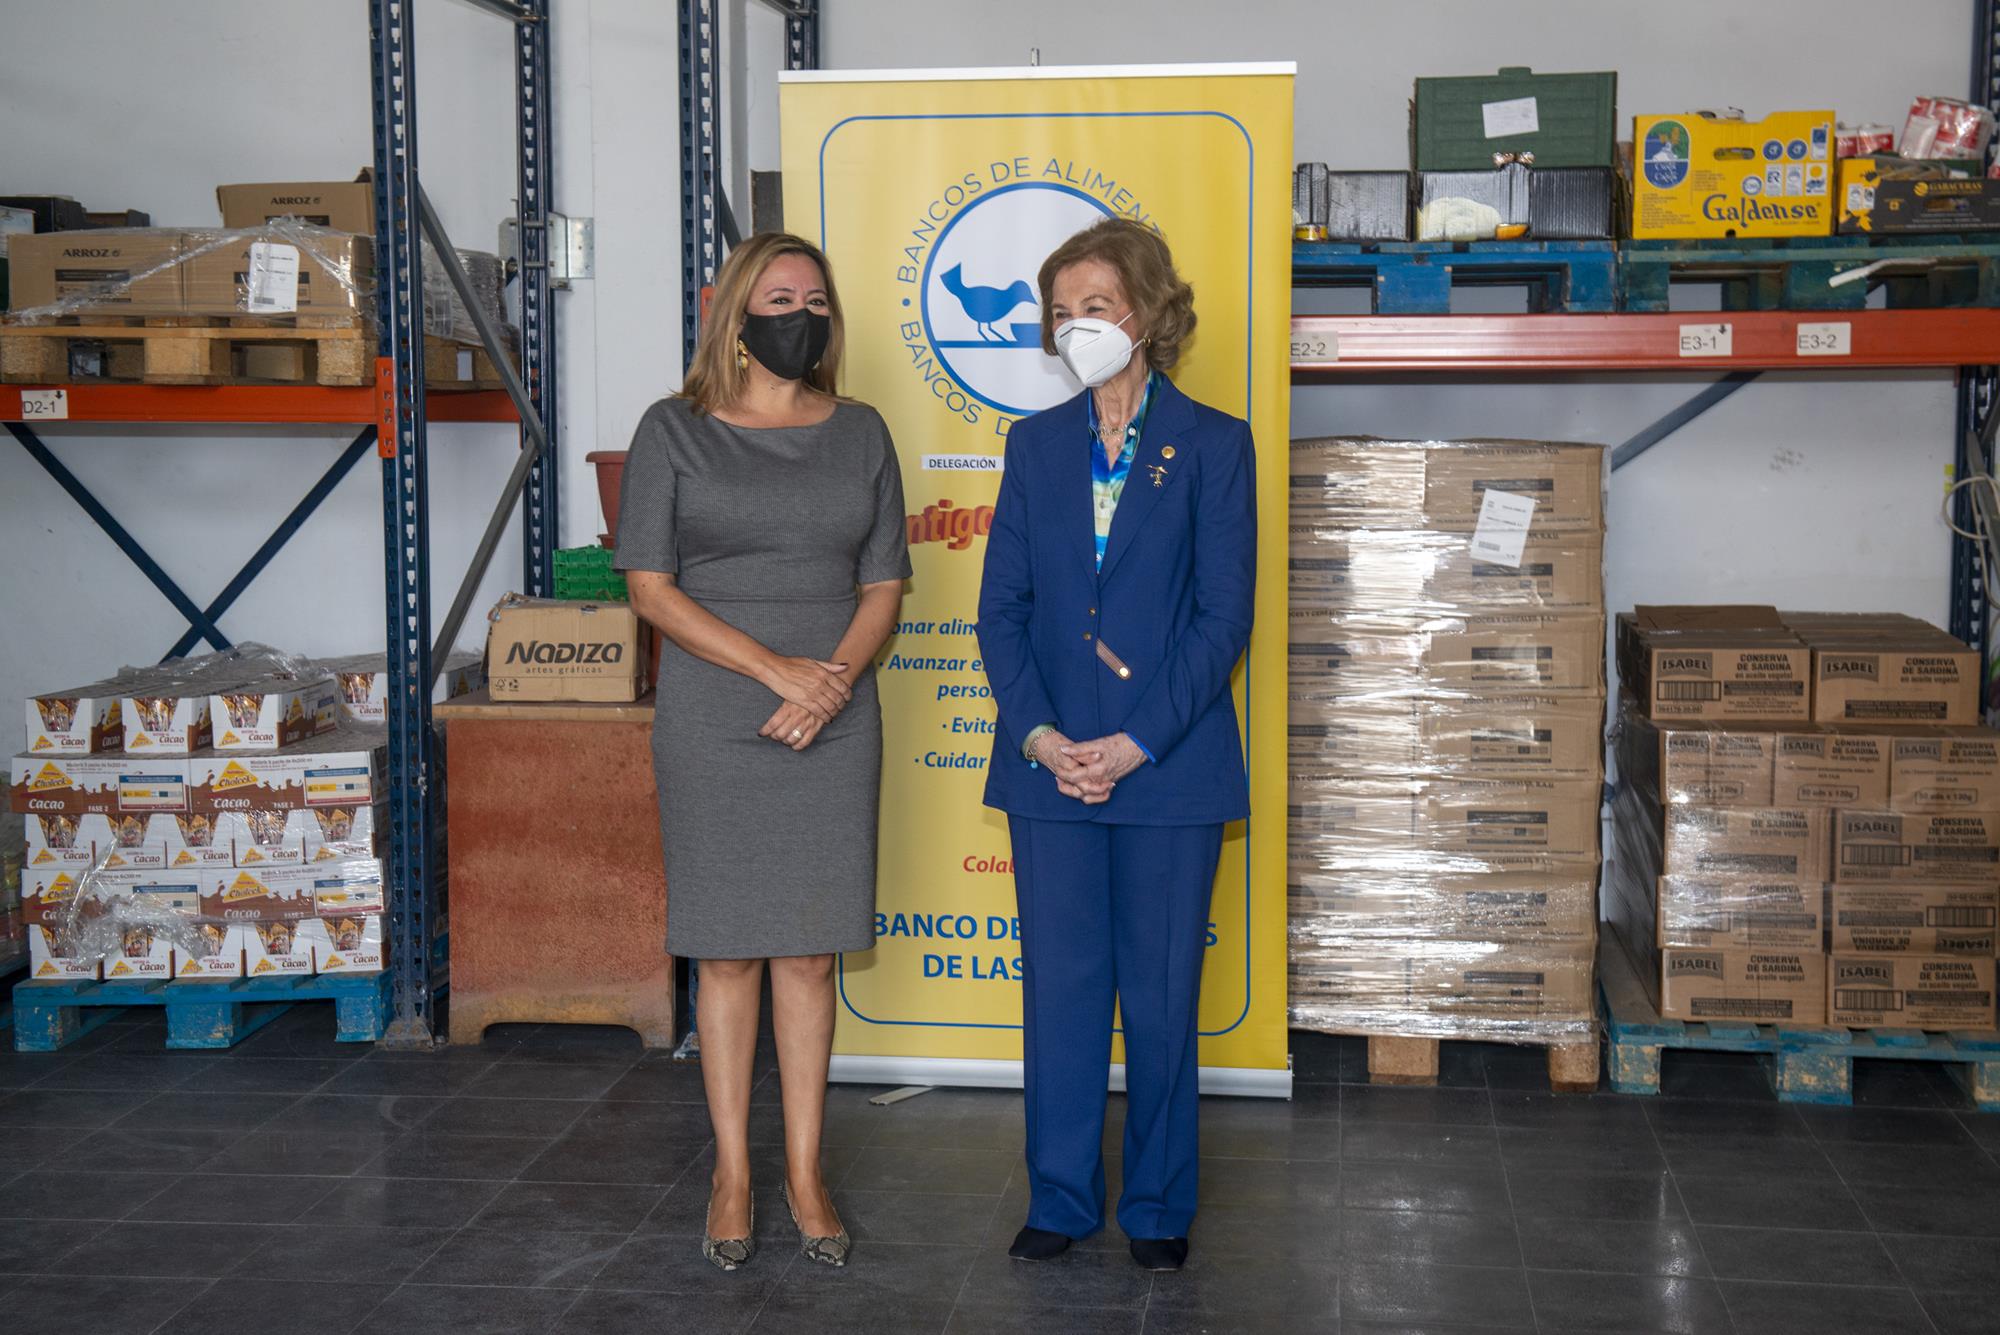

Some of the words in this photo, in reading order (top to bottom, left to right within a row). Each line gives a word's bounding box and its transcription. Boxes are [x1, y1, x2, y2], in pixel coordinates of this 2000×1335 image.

[270, 197, 313, 206] ARROZ
[1702, 193, 1819, 228] Galdense
[897, 173, 982, 284] BANCOS
[990, 157, 1030, 182] DE
[62, 248, 110, 258] ARROZ
[1680, 336, 1717, 351] E3-1
[1798, 334, 1837, 350] E3-2
[1290, 342, 1326, 356] E2-2
[901, 321, 983, 425] BANCOS
[23, 400, 56, 414] D2-1
[929, 458, 996, 468] DELEGACIÓN
[905, 498, 996, 550] ntigo
[888, 654, 967, 670] Avanzar
[971, 660, 986, 671] e
[1740, 653, 1788, 662] CONSERVA
[1905, 657, 1956, 666] CONSERVA
[558, 664, 602, 675] gráficas
[1662, 658, 1708, 670] ISABEL
[1827, 662, 1873, 673] ISABEL
[937, 685, 993, 700] perso
[951, 717, 996, 733] Evita
[61, 738, 85, 746] Cacao
[159, 736, 185, 744] Cacao
[248, 733, 274, 741] Cacao
[1834, 740, 1876, 748] CONSERVA
[1952, 742, 1994, 750] CONSERVA
[924, 752, 987, 768] Cuidar
[28, 799, 65, 810] Cacao
[213, 798, 250, 809] Cacao
[1931, 818, 1983, 826] CONSERVA
[1848, 822, 1897, 834] ISABEL
[63, 852, 90, 860] Cacao
[134, 855, 160, 863] Cacao
[203, 852, 229, 860] Cacao
[272, 850, 298, 858] Cacao
[224, 908, 261, 919] Cacao
[873, 913, 978, 940] BANCO
[282, 960, 307, 968] Cacao
[353, 955, 379, 963] Cacao
[1750, 955, 1800, 964] CONSERVA
[139, 963, 165, 971] Cacao
[209, 961, 235, 969] Cacao
[923, 954, 963, 979] DE
[971, 955, 1024, 981] LAS
[1672, 959, 1718, 971] ISABEL
[1922, 963, 1973, 971] CONSERVA
[1840, 967, 1888, 978] ISABEL
